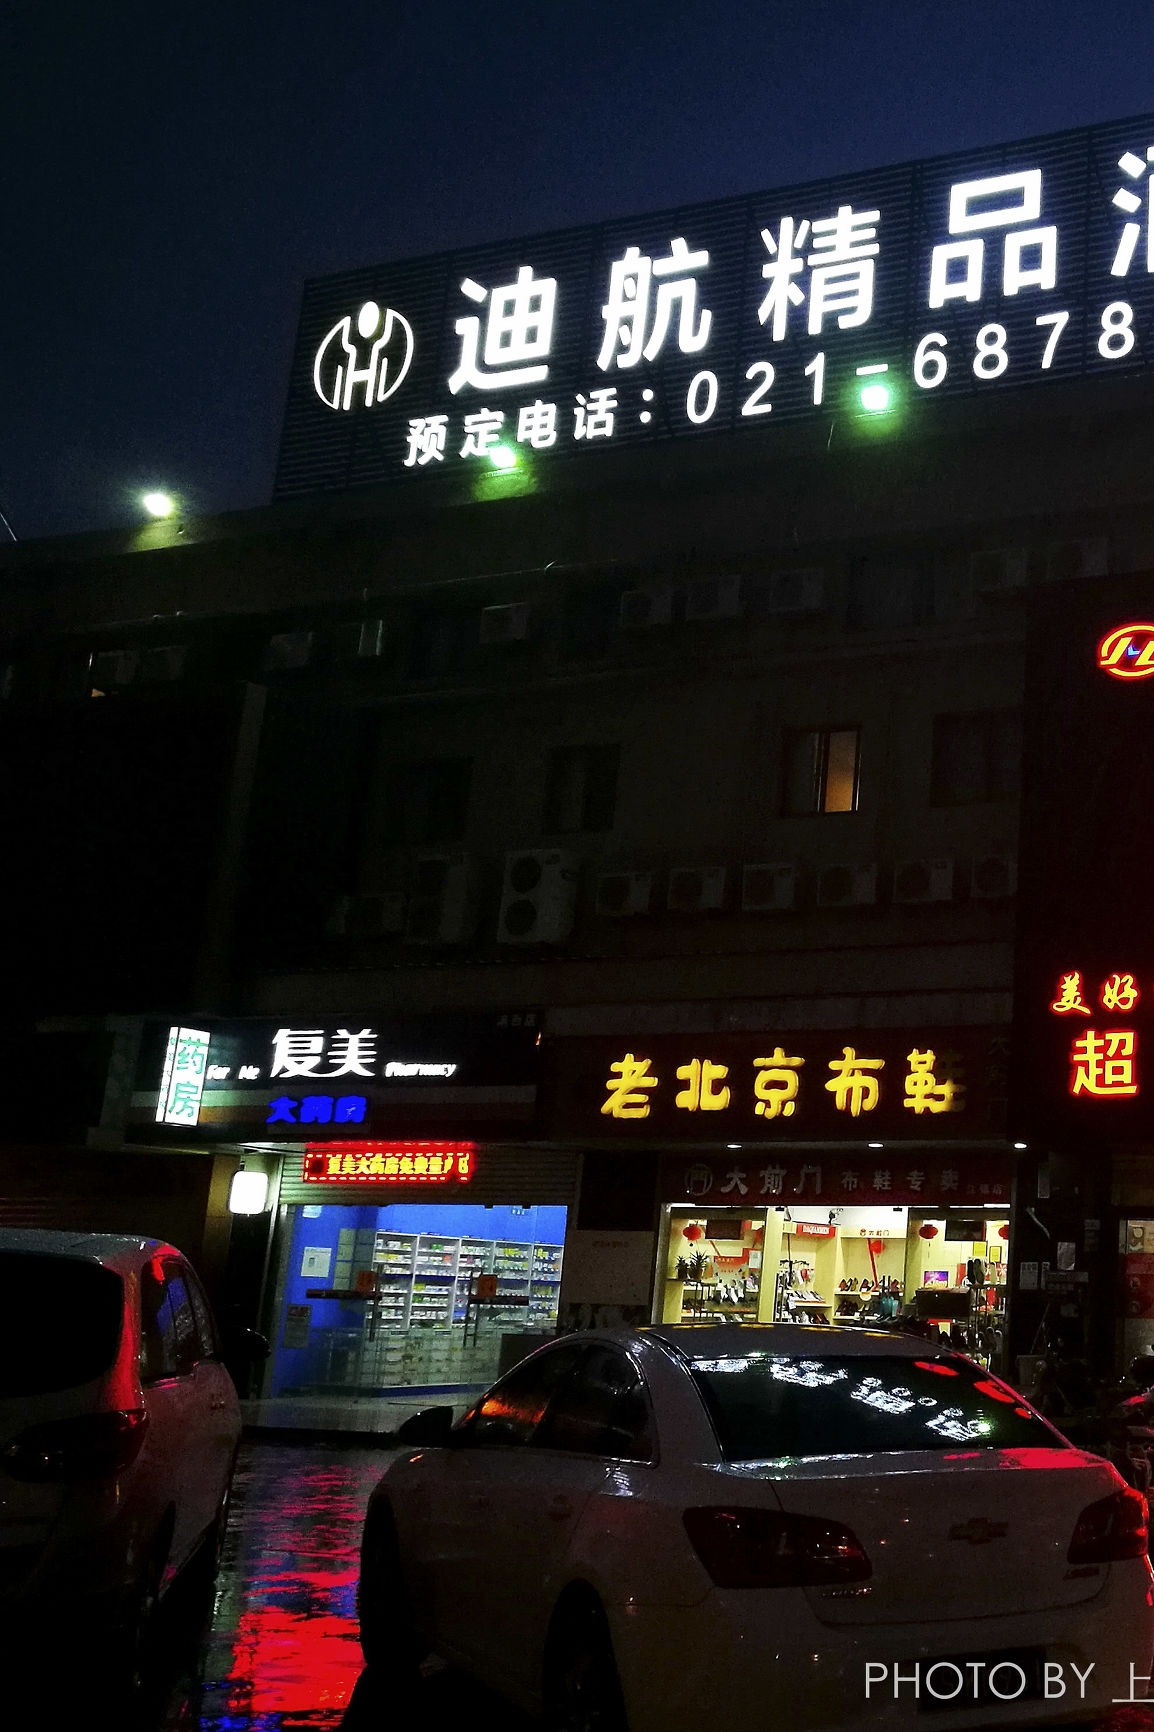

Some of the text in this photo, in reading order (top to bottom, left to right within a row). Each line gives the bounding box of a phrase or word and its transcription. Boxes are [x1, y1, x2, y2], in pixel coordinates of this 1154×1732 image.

[270, 1028, 378, 1078] 复美
[168, 1036, 209, 1118] 药房
[266, 1095, 367, 1123] 大药房
[720, 1163, 823, 1197] 大前门
